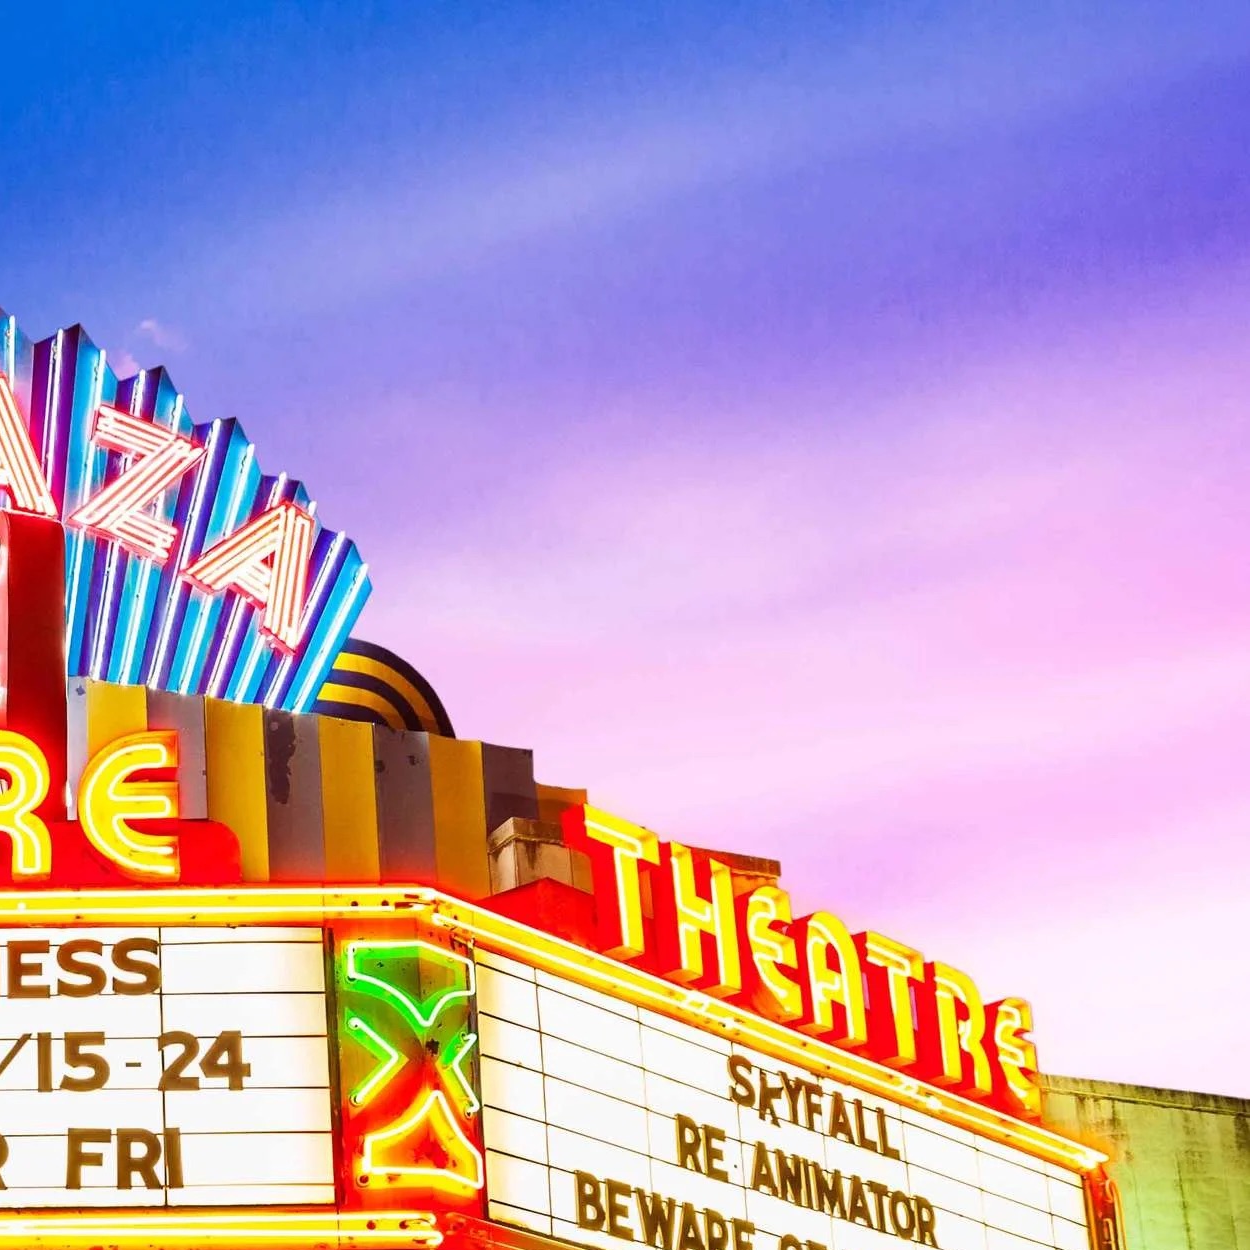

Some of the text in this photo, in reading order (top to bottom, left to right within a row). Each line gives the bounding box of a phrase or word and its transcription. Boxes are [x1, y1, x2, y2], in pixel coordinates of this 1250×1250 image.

[584, 803, 1042, 1126] THEATRE
[66, 1128, 184, 1190] FRI
[727, 1055, 900, 1160] SKYFALL
[675, 1113, 939, 1248] RE ANIMATOR
